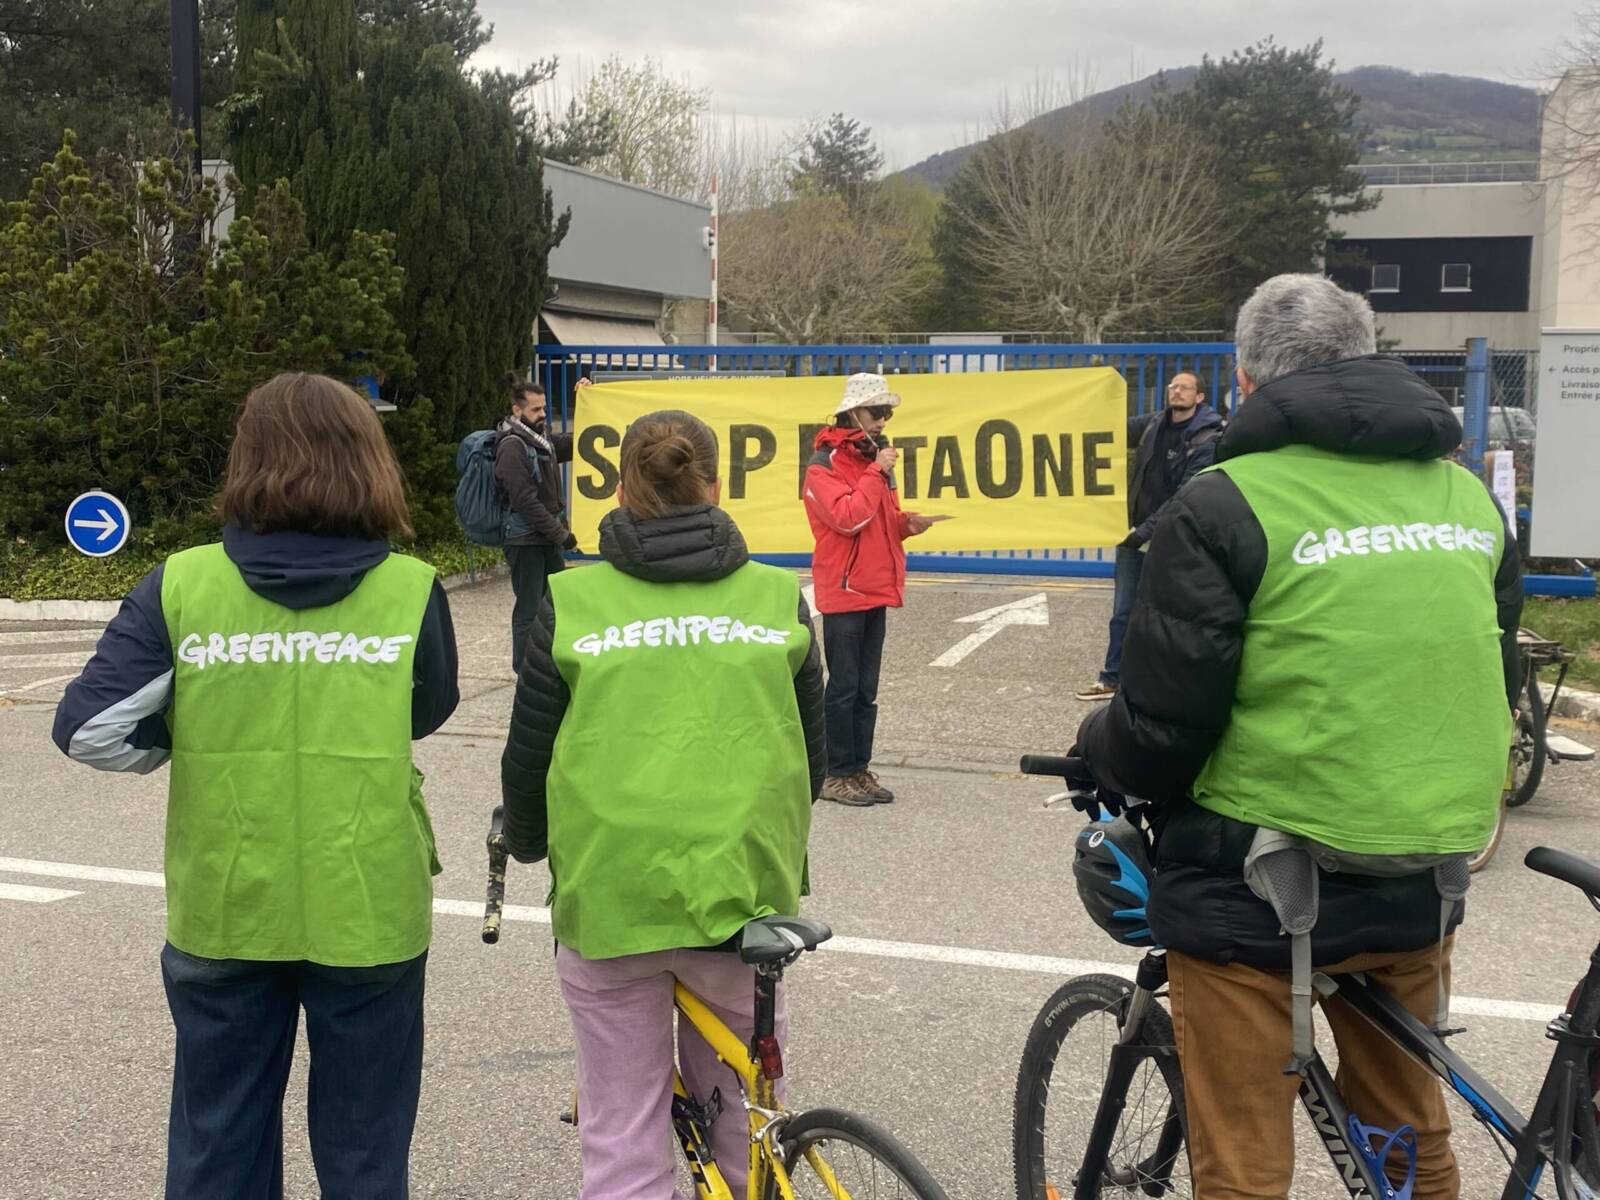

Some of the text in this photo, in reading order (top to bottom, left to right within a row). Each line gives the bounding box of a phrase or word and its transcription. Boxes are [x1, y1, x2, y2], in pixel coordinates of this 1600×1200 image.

[1562, 364, 1591, 374] Accès
[1560, 390, 1593, 400] Entrée
[576, 418, 1116, 500] SP TAONE
[1292, 522, 1498, 565] GREENPEACE
[178, 631, 413, 670] GREENPEACE
[572, 615, 791, 656] GREENPEACE
